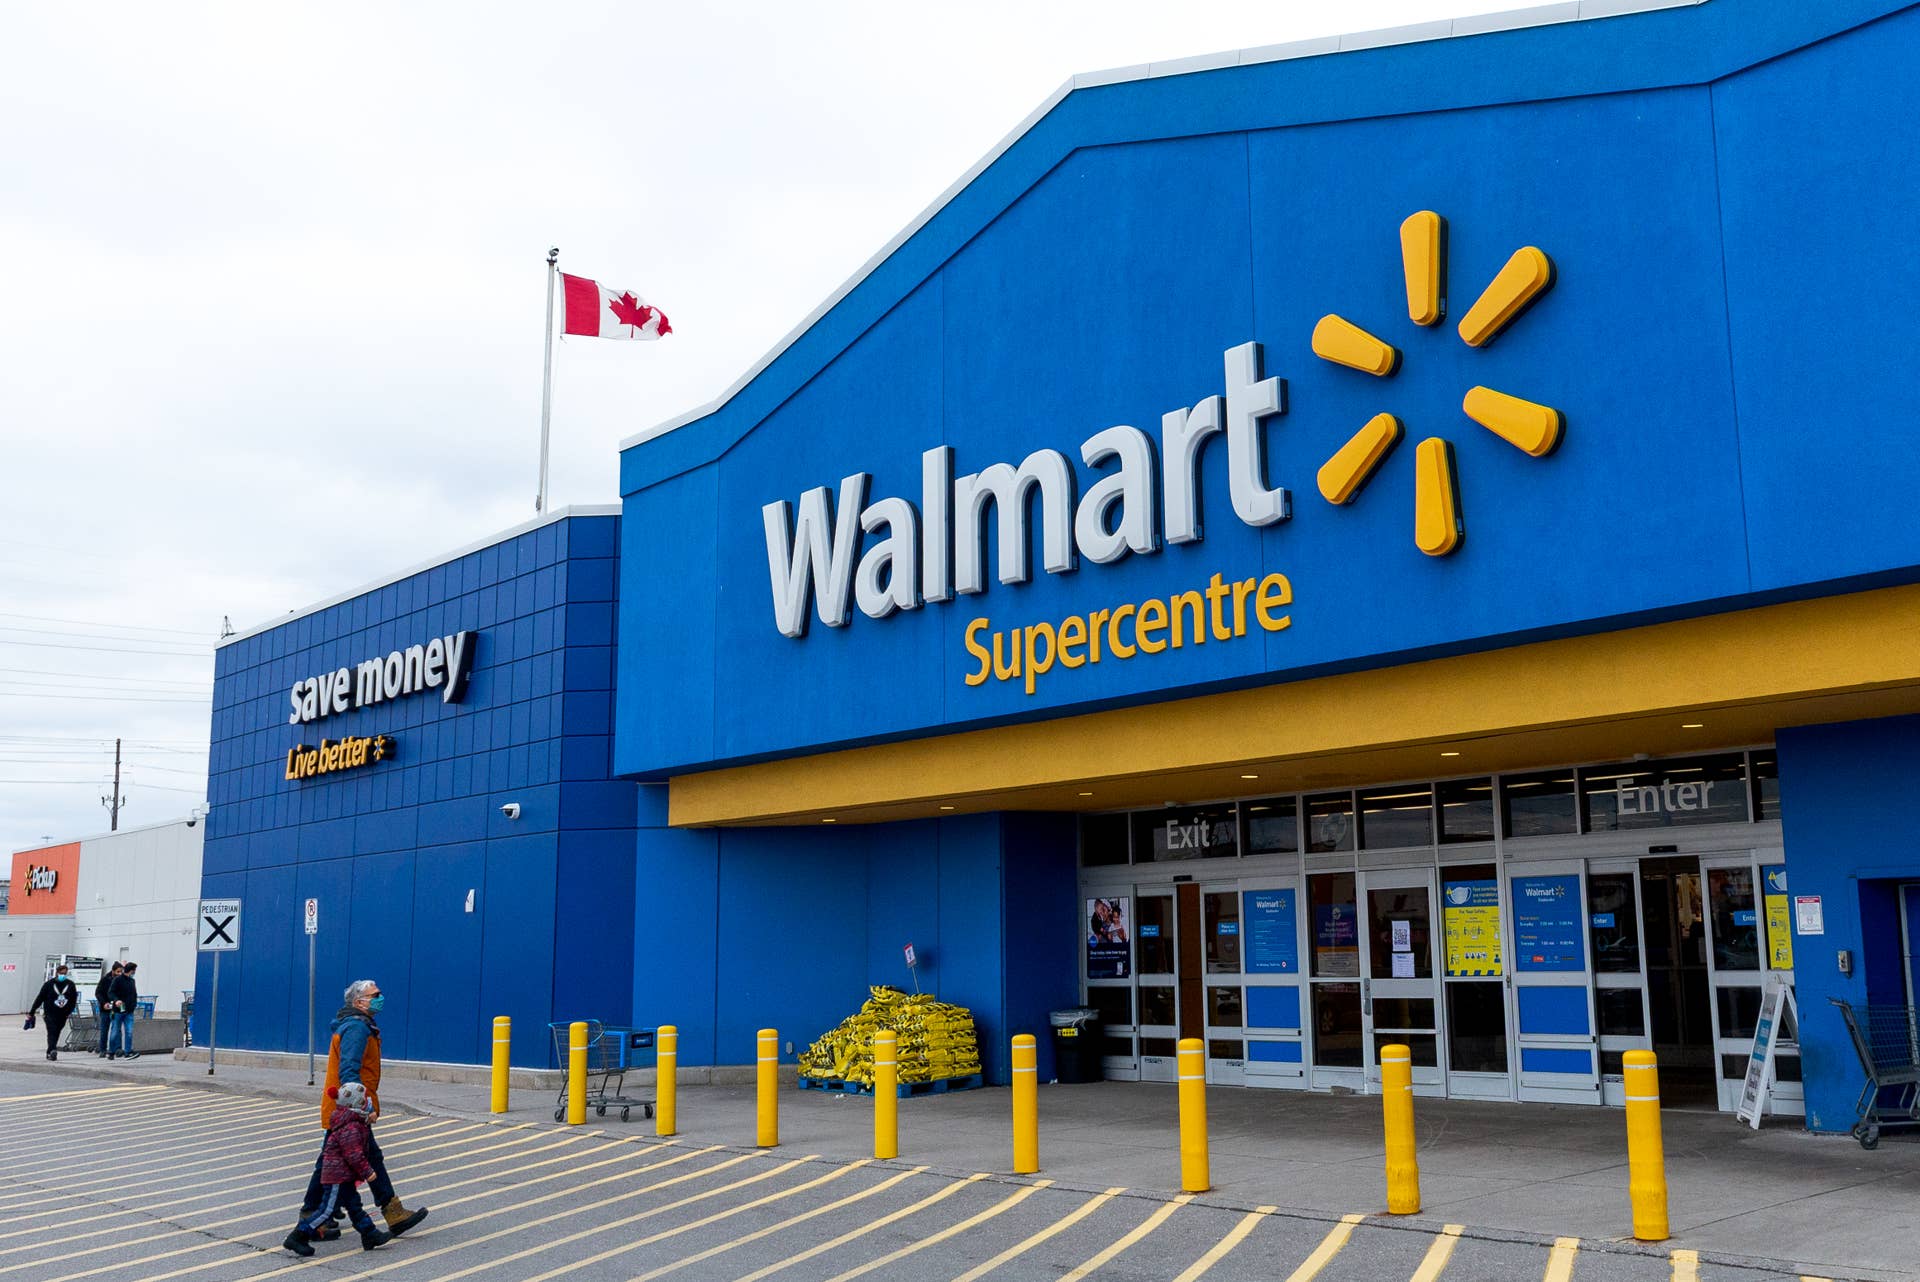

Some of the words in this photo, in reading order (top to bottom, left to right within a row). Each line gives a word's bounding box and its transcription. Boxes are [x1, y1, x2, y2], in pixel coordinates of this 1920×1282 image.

[762, 340, 1291, 637] Walmart
[965, 572, 1293, 694] Supercentre
[290, 667, 350, 724] save
[355, 631, 467, 703] money
[285, 743, 317, 780] Live
[318, 736, 373, 773] better
[1616, 778, 1715, 815] Enter
[1167, 817, 1210, 849] Exit
[32, 866, 56, 893] Pickup
[1525, 888, 1555, 896] Walmart
[201, 905, 238, 914] PEDESTRIAN
[1256, 901, 1279, 909] Walmart
[1742, 914, 1756, 922] Ente
